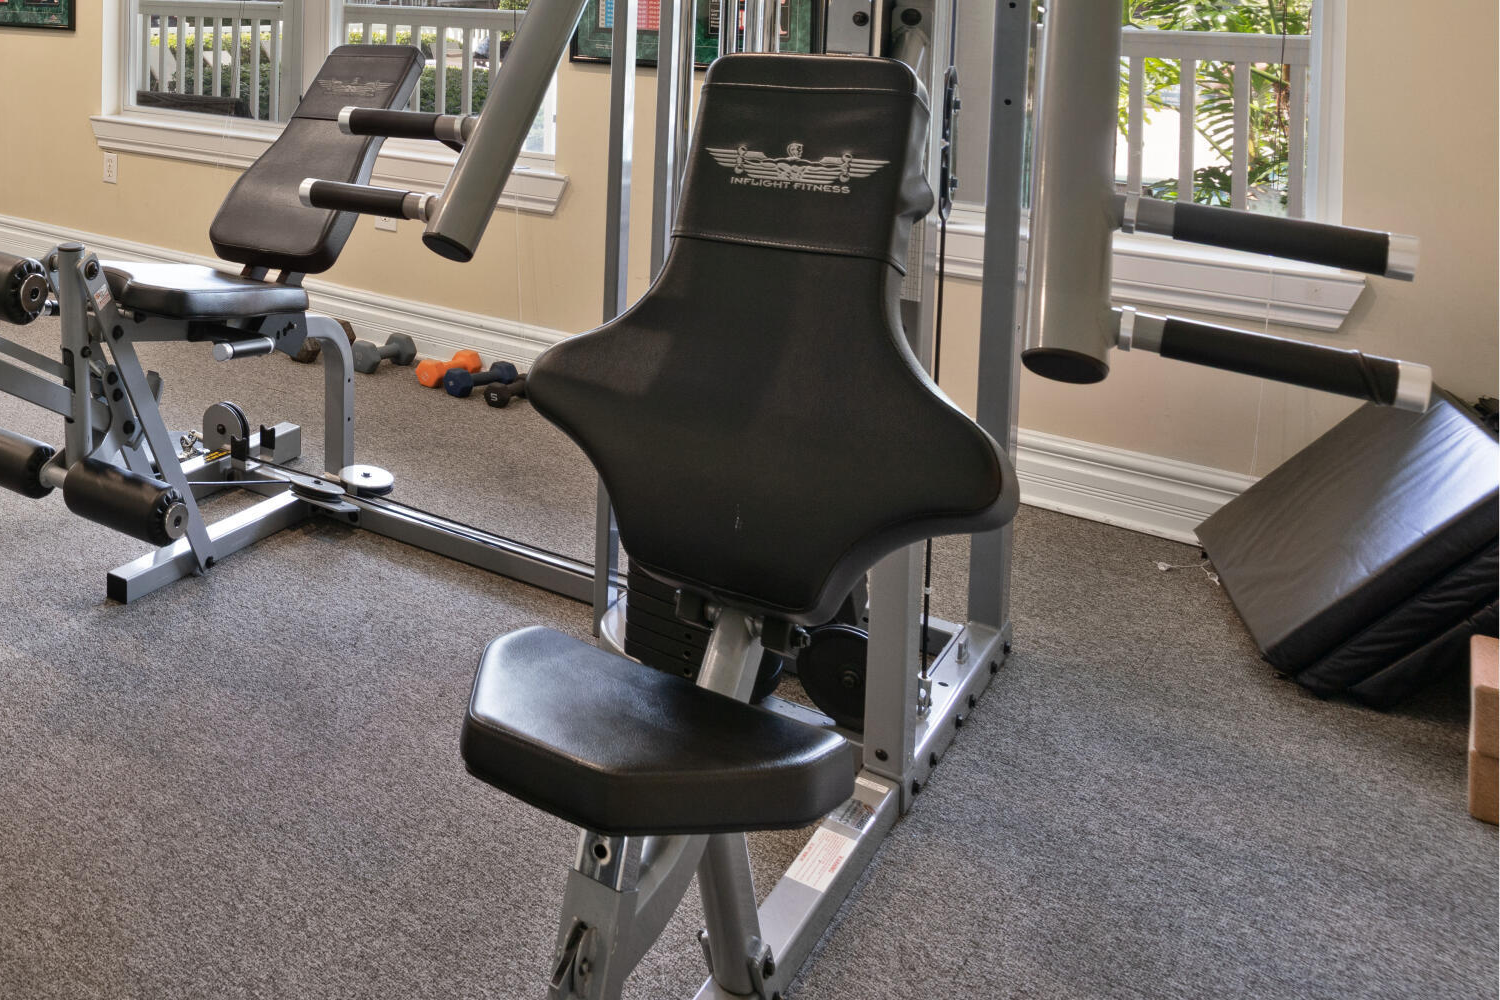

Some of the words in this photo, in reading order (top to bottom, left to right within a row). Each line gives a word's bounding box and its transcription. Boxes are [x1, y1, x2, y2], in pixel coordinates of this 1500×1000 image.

[730, 176, 791, 189] INFLIGHT
[794, 182, 851, 194] FITNESS
[490, 392, 498, 401] 5
